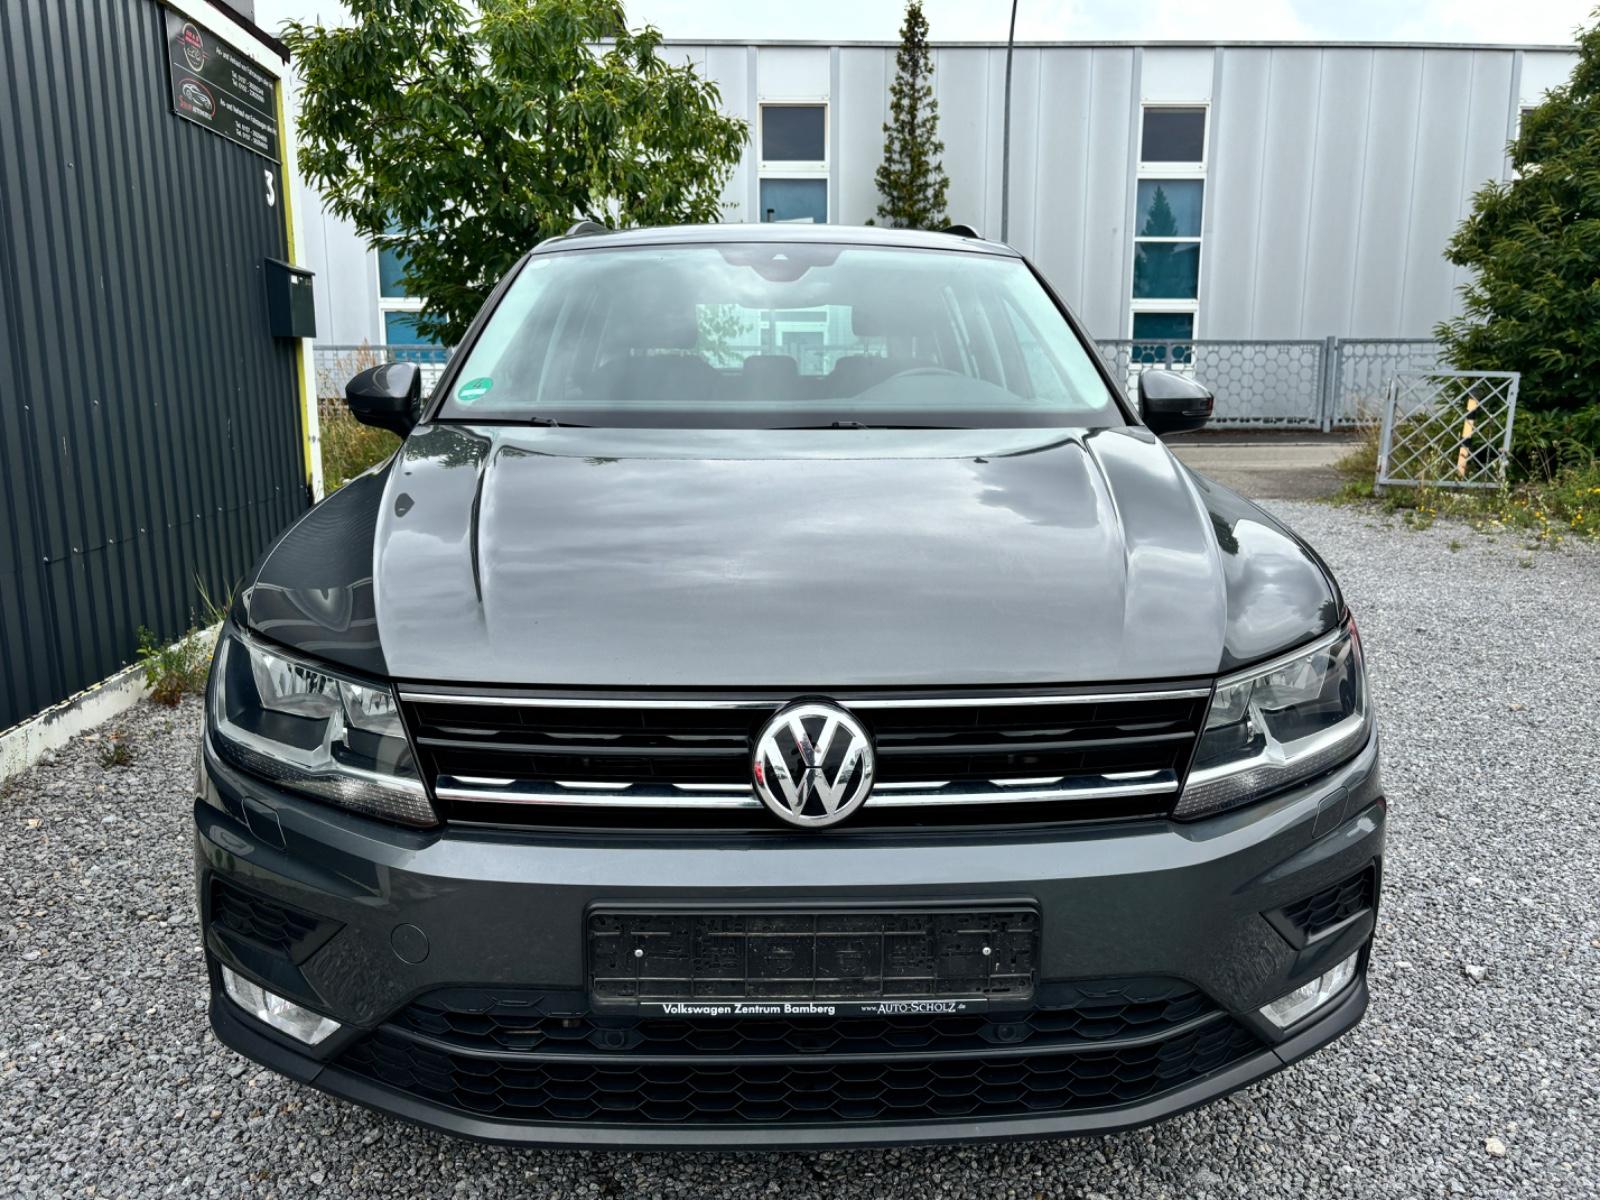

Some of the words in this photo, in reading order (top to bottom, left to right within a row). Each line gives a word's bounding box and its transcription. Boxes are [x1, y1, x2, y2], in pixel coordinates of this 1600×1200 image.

[264, 169, 275, 207] 3
[753, 705, 874, 827] VW
[662, 1002, 731, 1015] Volkswagen
[734, 1002, 780, 1014] Zentrum
[783, 1002, 836, 1015] Bamberg
